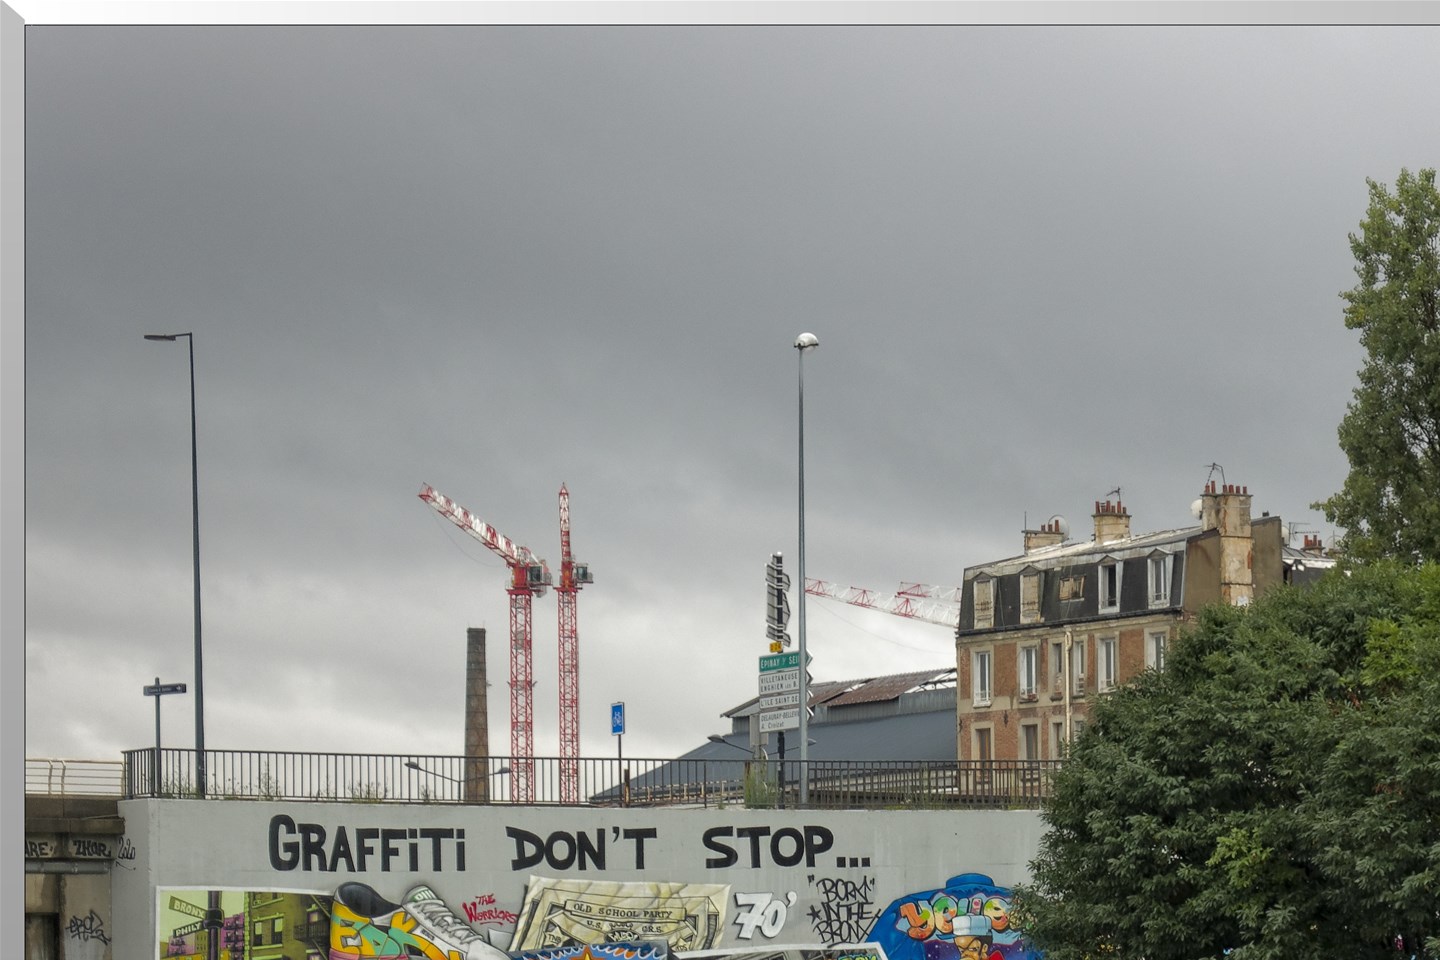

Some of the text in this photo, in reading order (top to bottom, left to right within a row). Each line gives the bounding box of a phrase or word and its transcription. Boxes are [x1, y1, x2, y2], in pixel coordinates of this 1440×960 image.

[788, 655, 800, 665] SEI
[506, 825, 657, 871] DON'T
[703, 825, 871, 869] STOP...
[173, 899, 205, 918] BRONX
[475, 893, 496, 906] THE
[574, 903, 673, 920] OLD SCHOOL PARTY
[837, 901, 874, 920] THE
[175, 922, 201, 937] PHILY
[813, 908, 881, 944] BRONX
